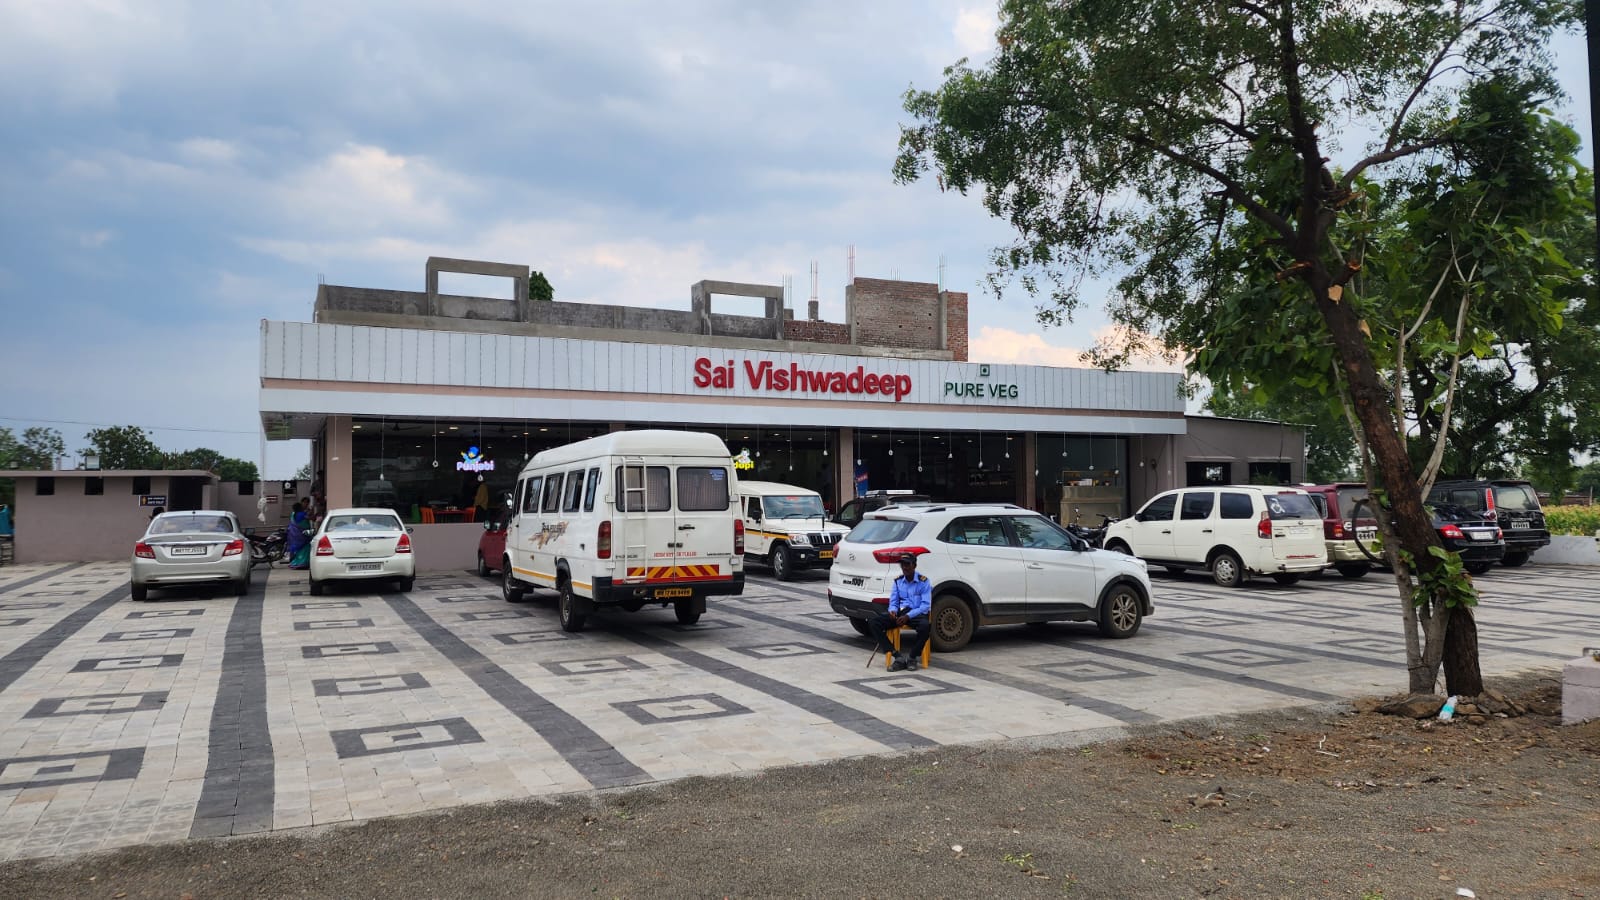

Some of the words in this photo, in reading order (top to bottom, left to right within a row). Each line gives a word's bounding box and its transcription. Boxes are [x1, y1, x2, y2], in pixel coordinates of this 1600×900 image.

[693, 357, 735, 389] Sai
[743, 360, 912, 401] Vishwadeep
[944, 382, 985, 398] PURE
[989, 383, 1019, 399] VEG
[456, 460, 494, 472] Punjabi
